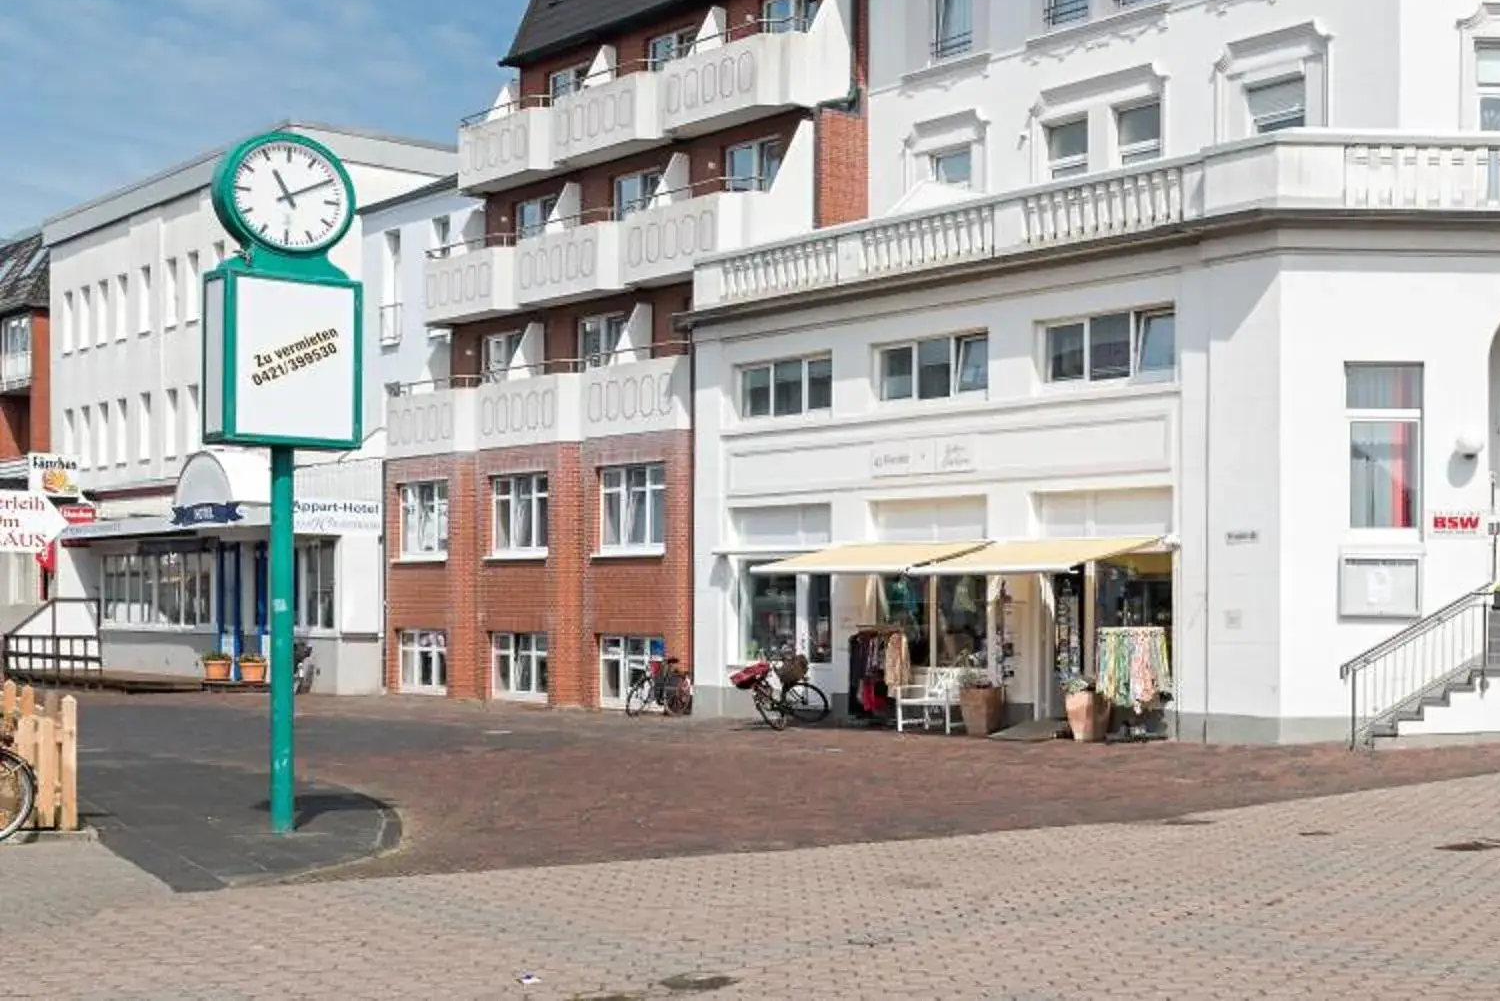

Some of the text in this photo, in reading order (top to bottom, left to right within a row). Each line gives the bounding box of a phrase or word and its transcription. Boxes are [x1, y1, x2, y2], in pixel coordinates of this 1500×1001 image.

[254, 328, 338, 368] Zu vermieten
[293, 500, 379, 515] Appart-Hotel
[1433, 516, 1479, 529] BSW
[0, 532, 47, 548] AUS
